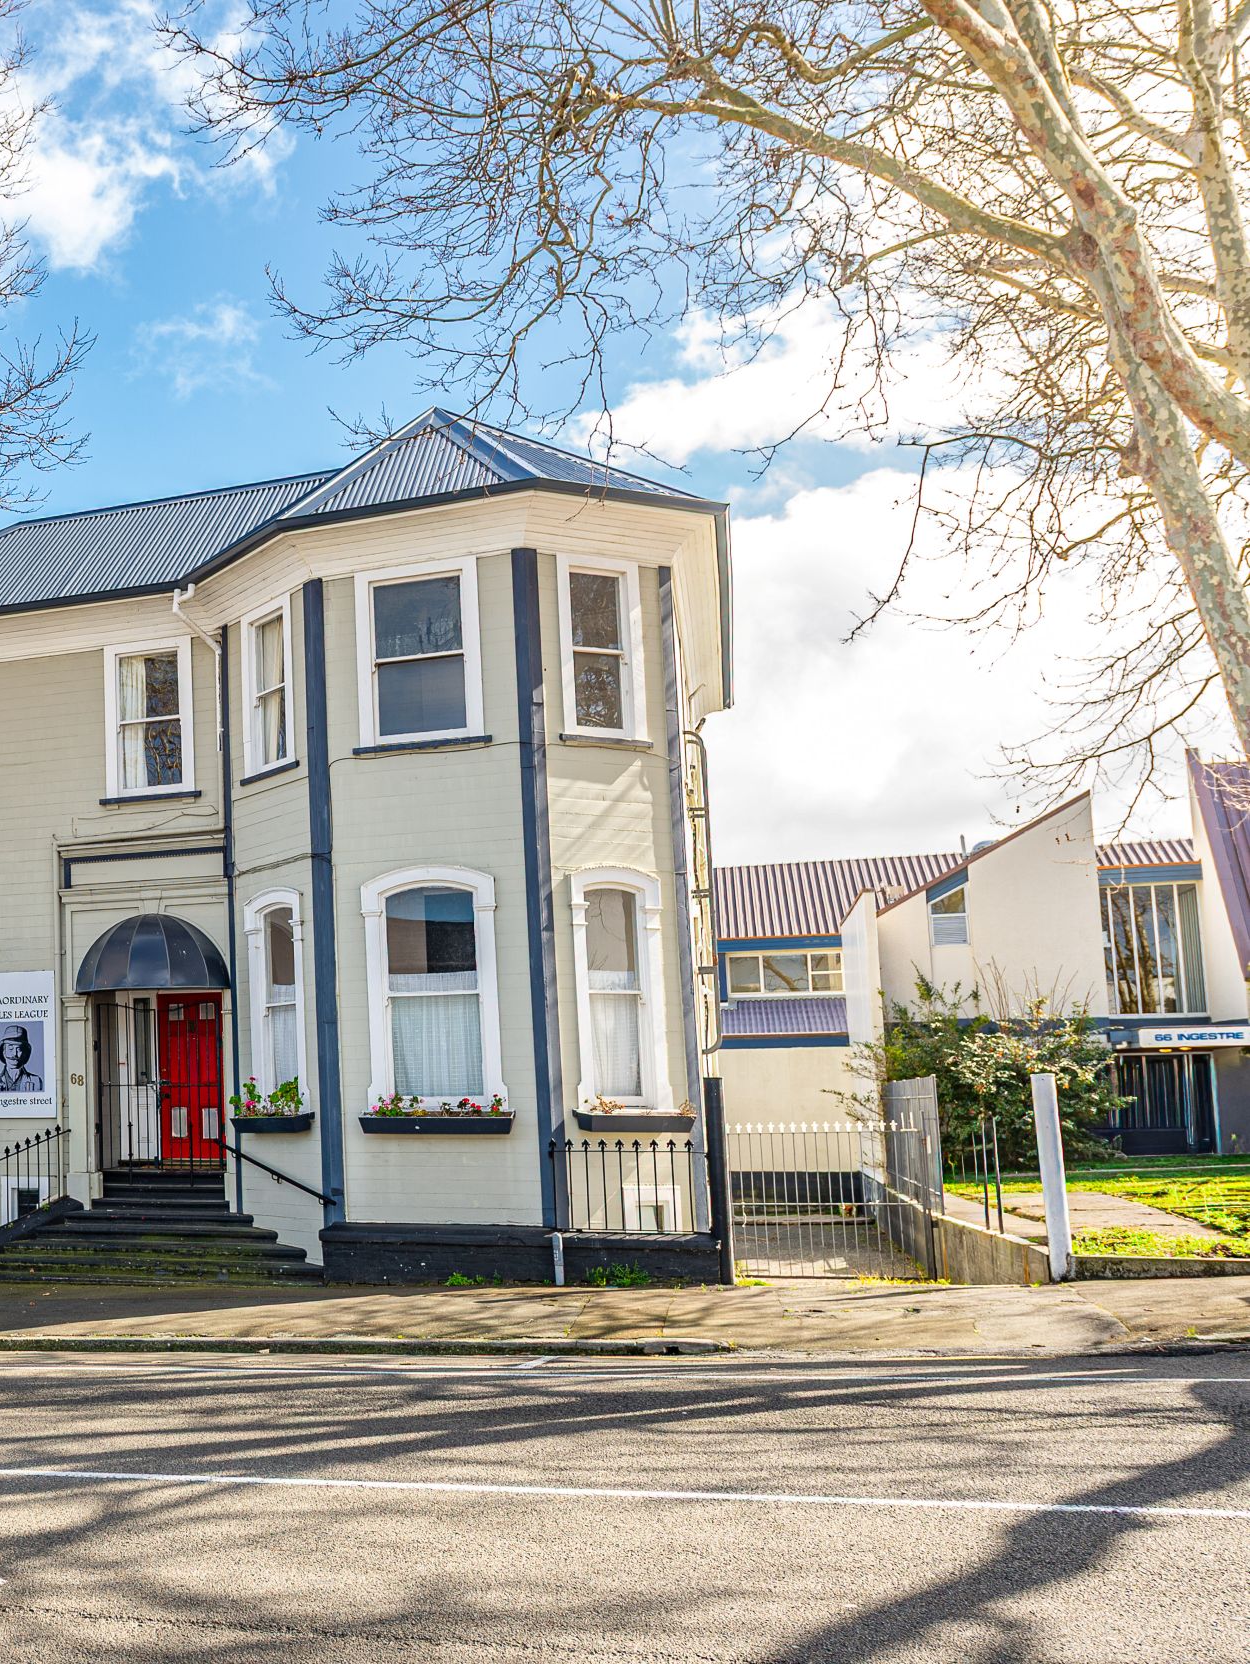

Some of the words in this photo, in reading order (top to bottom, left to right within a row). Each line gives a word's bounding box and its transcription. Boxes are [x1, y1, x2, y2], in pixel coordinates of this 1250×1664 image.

[14, 1009, 49, 1019] LEAGUE
[1154, 1033, 1172, 1041] 66
[1177, 1031, 1245, 1041] INGESTRE
[70, 1073, 85, 1087] 68
[29, 1096, 53, 1106] street
